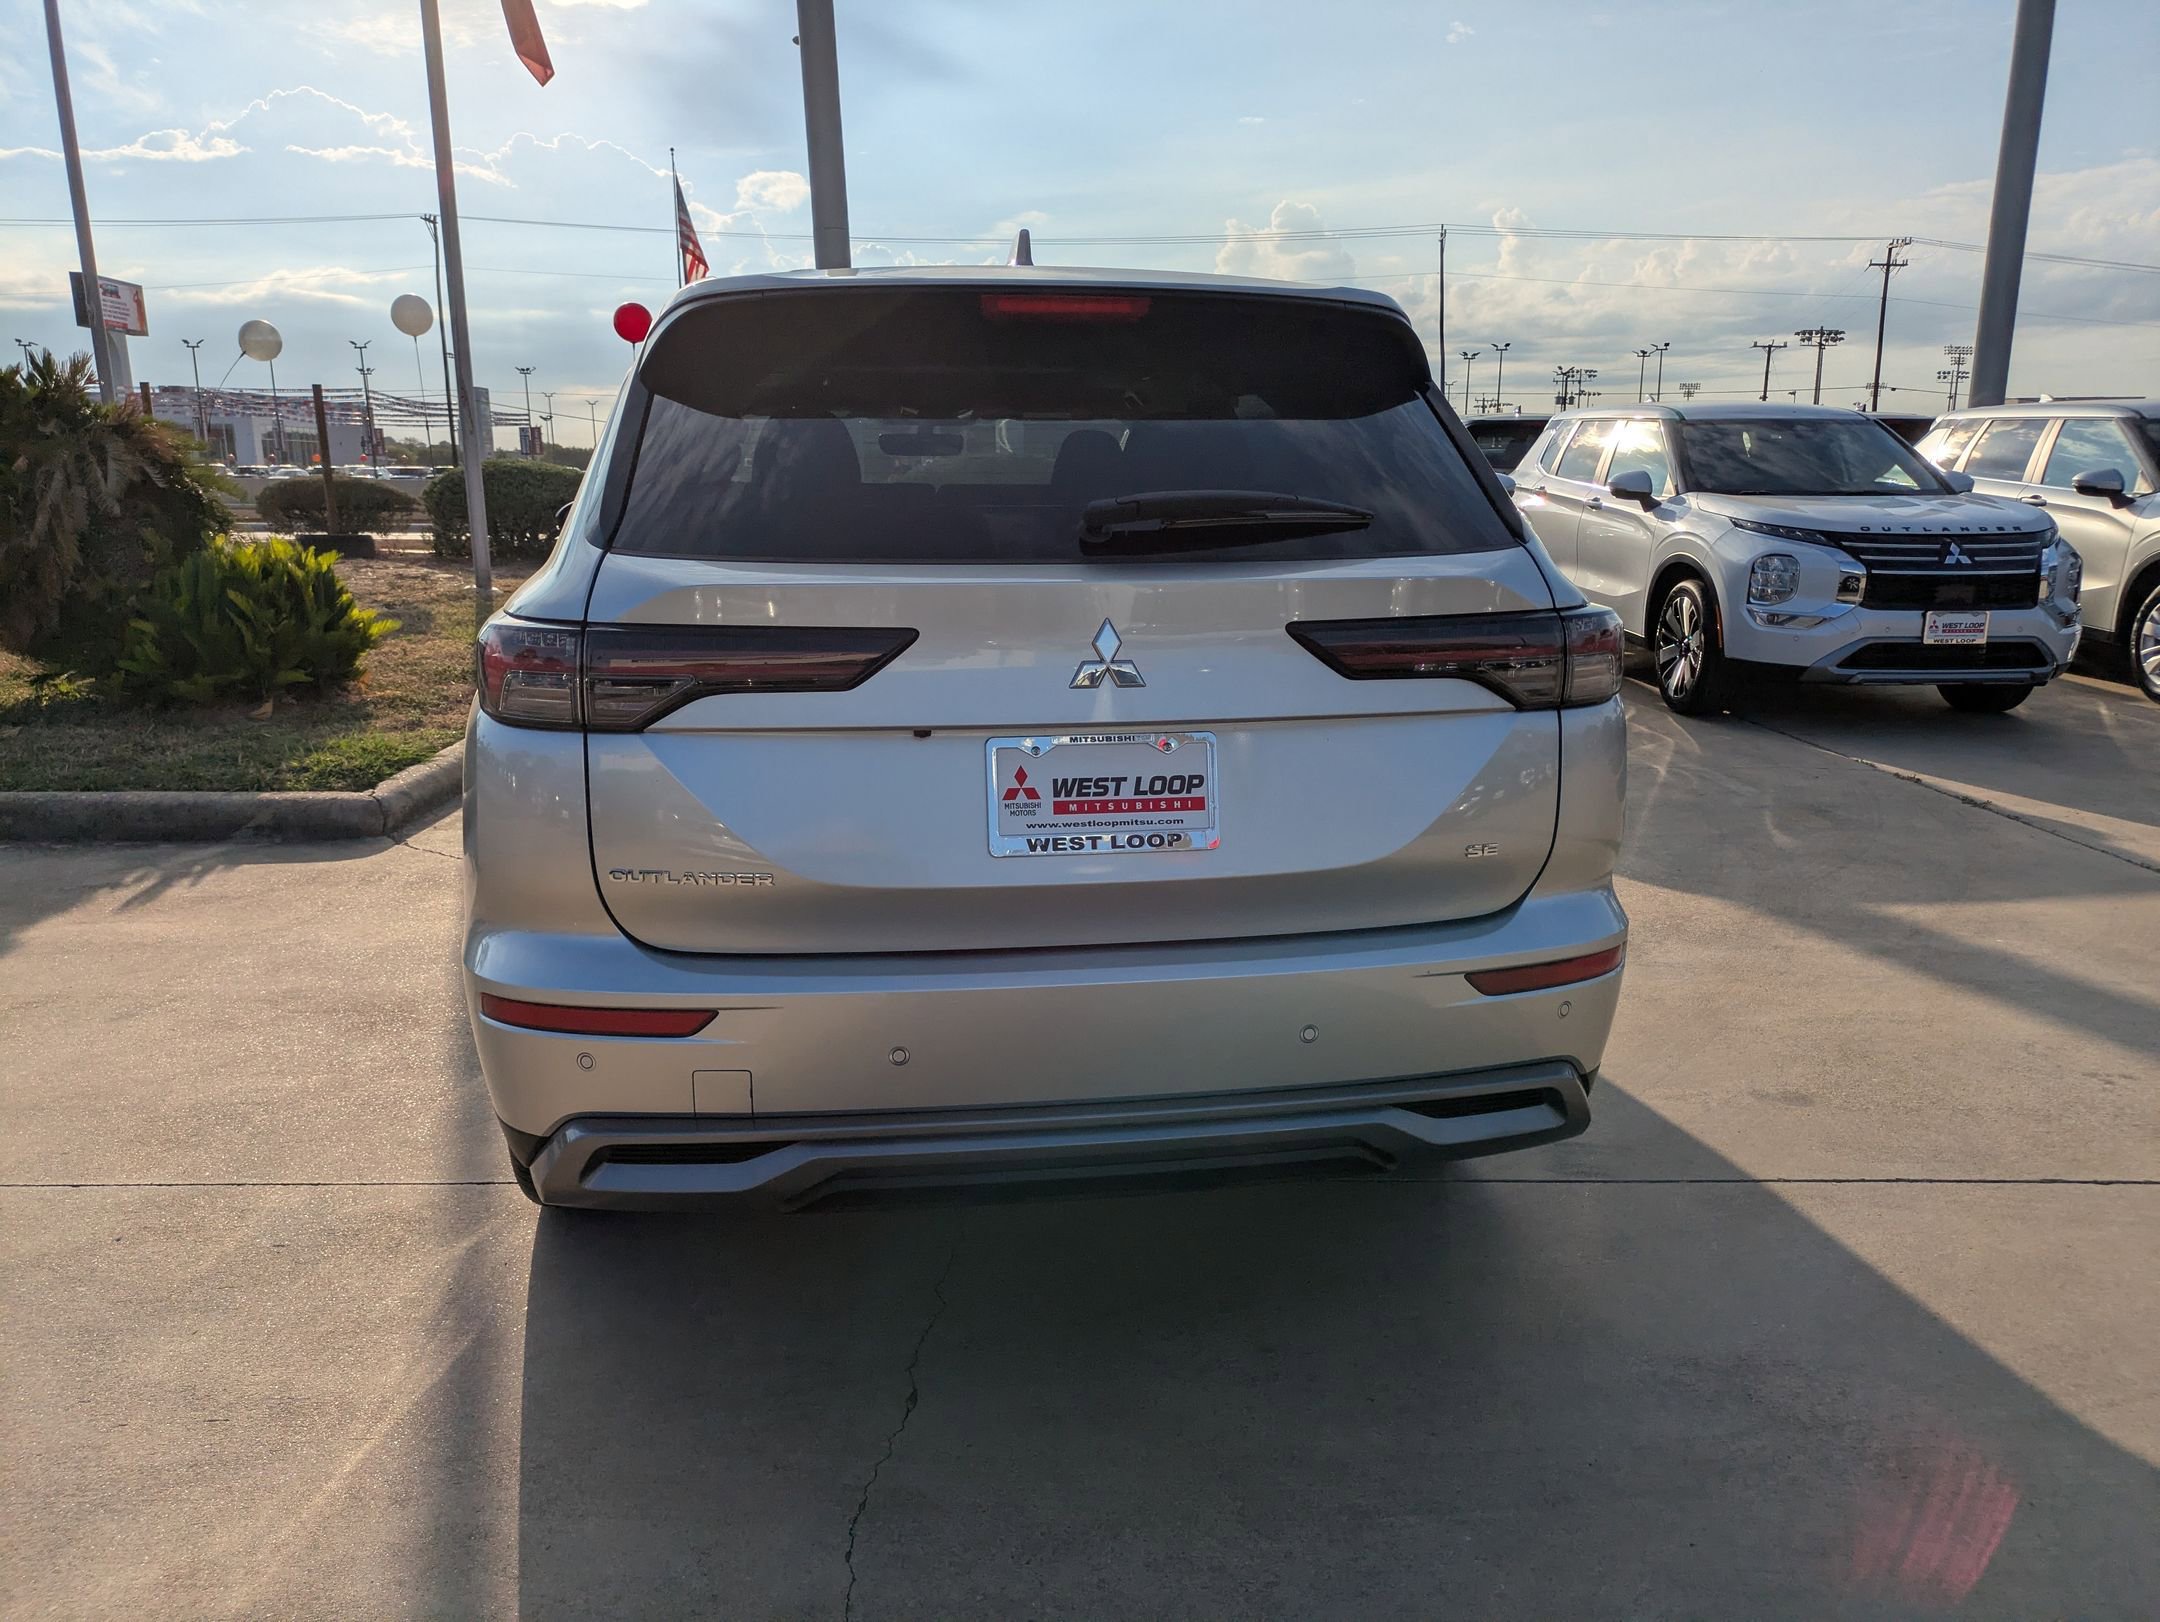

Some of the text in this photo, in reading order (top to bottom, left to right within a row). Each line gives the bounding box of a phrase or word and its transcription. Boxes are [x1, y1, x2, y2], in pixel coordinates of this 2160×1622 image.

[1069, 735, 1136, 743] MITSUBISHI
[1052, 774, 1205, 798] WEST LOOP
[1004, 802, 1042, 810] MITSUBISHI
[1068, 800, 1193, 812] MITSUBISHI
[1009, 809, 1037, 817] MOTORS
[1025, 818, 1184, 830] www.westloopmitsu.com
[1026, 833, 1183, 853] WEST LOOP
[1464, 842, 1499, 858] SE
[608, 868, 776, 887] OUTLANDER
